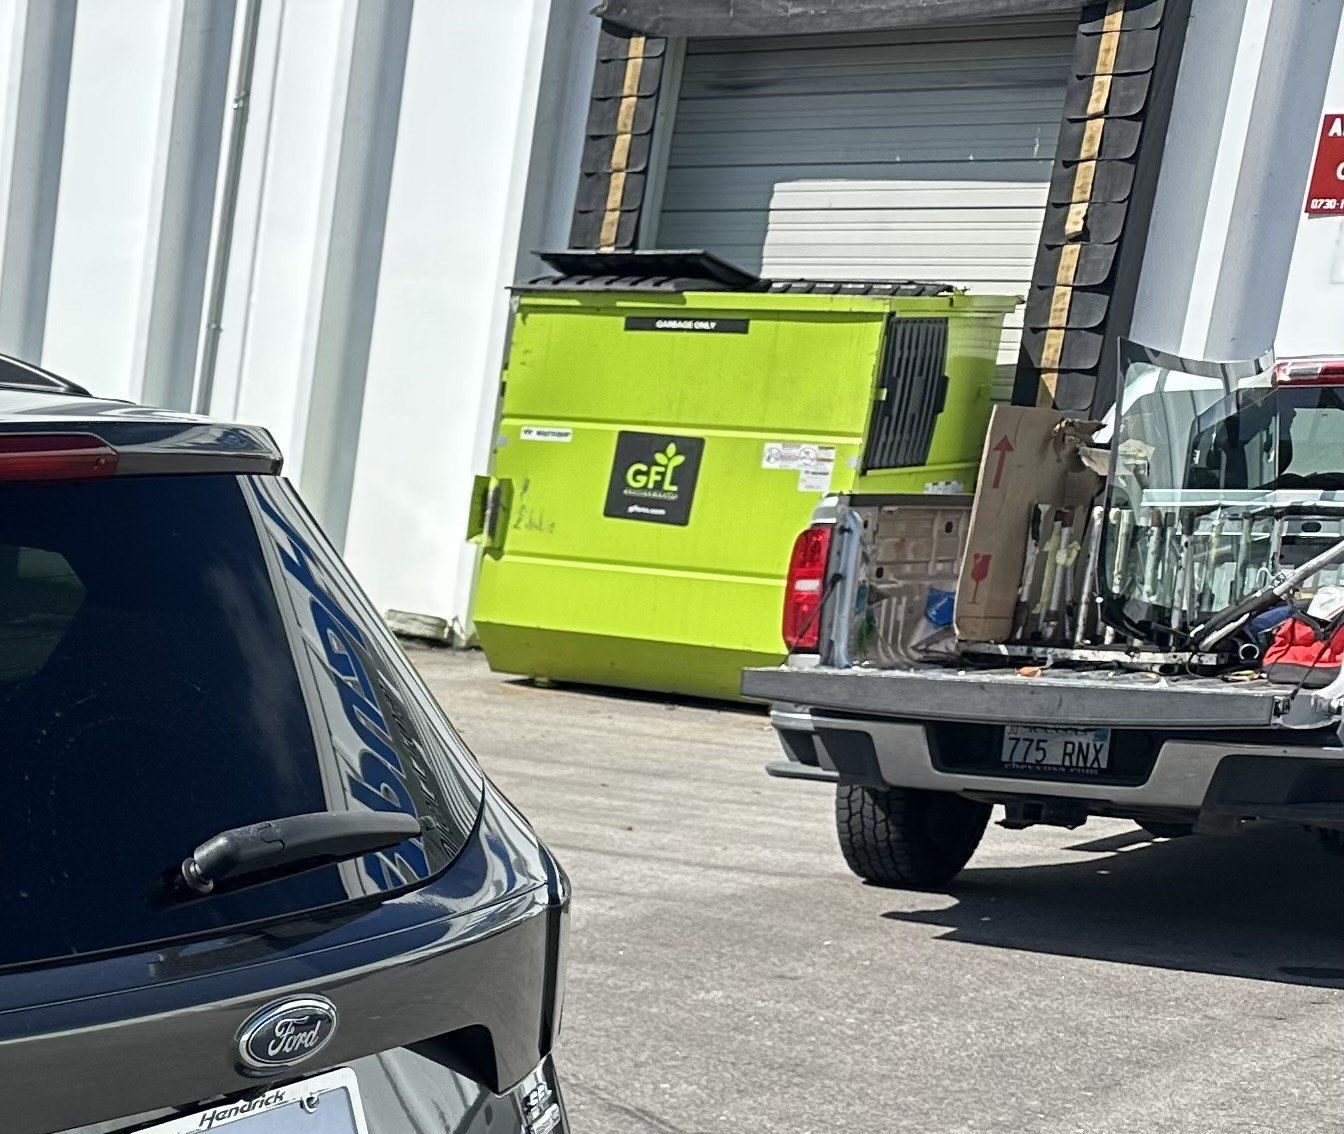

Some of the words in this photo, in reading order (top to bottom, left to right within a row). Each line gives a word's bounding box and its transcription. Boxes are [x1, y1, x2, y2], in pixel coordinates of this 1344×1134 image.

[626, 458, 678, 492] GFL
[1008, 736, 1048, 764] 775
[1061, 740, 1104, 769] RNX
[267, 1014, 322, 1057] Ford
[198, 1089, 287, 1129] Hendrick
